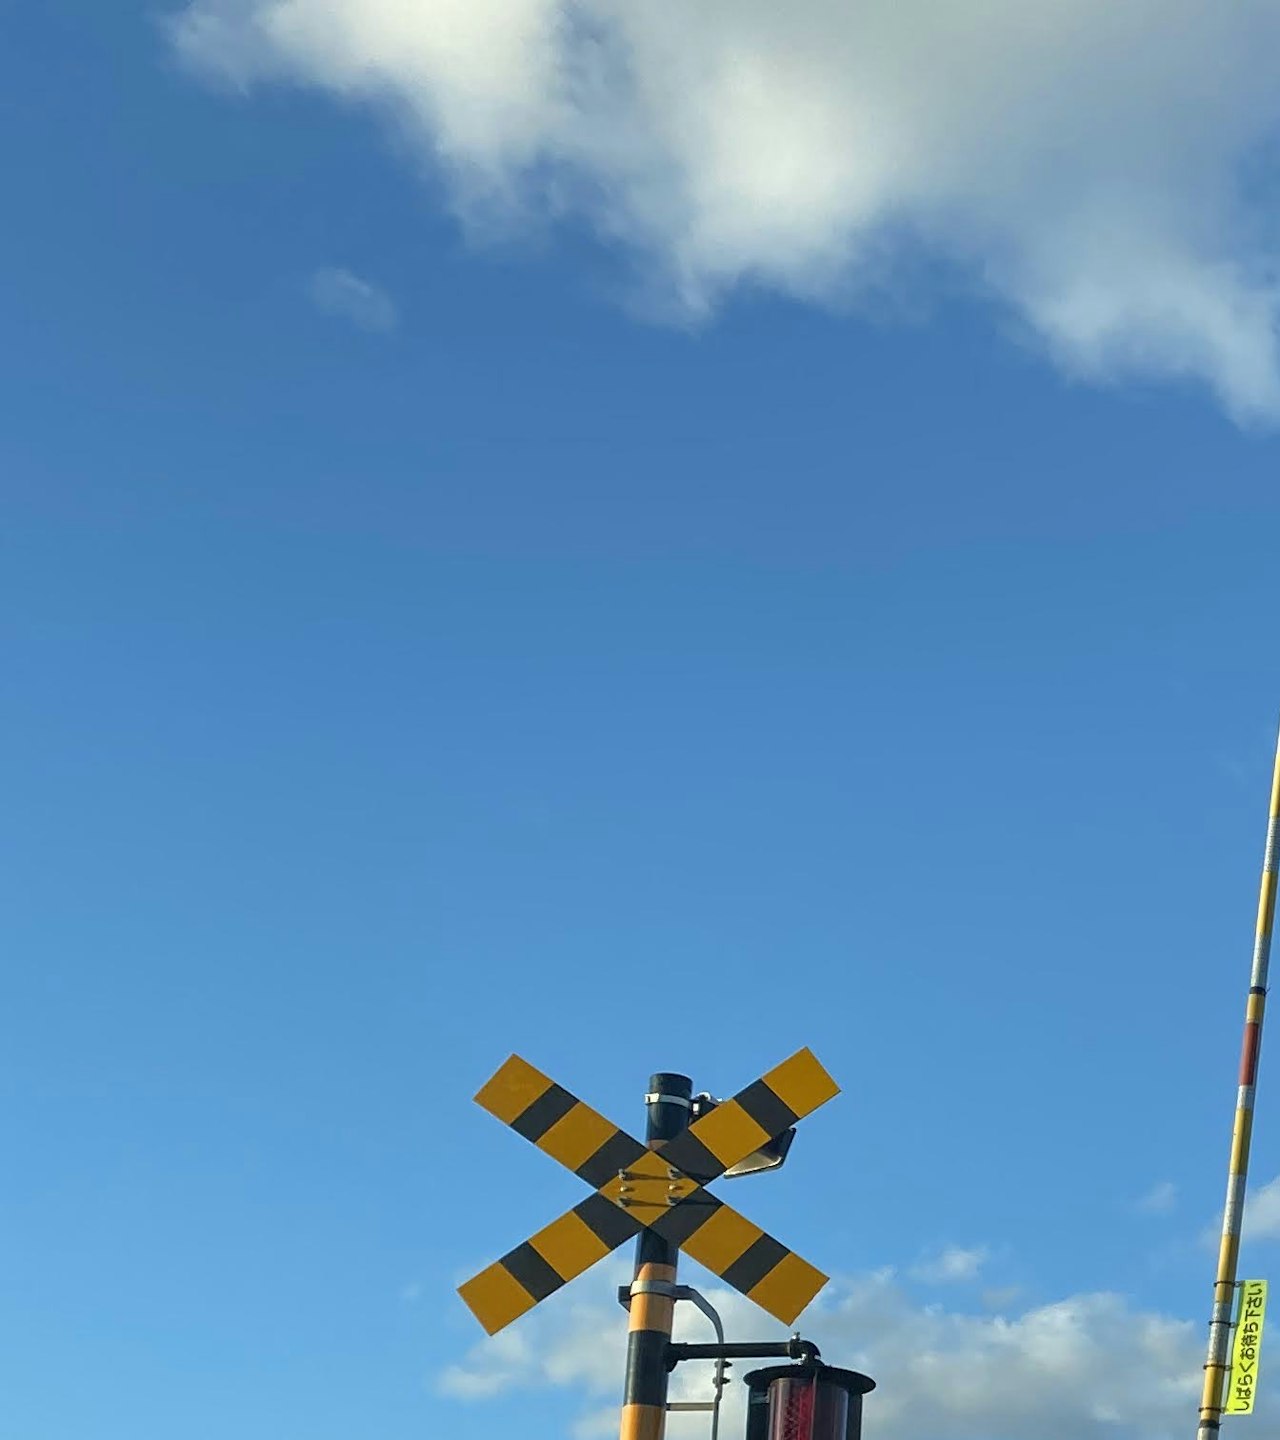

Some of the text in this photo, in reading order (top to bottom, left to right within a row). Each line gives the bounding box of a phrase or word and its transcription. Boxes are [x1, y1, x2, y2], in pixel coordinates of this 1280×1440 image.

[1234, 1283, 1263, 1411] しばらくお待ち下さい
